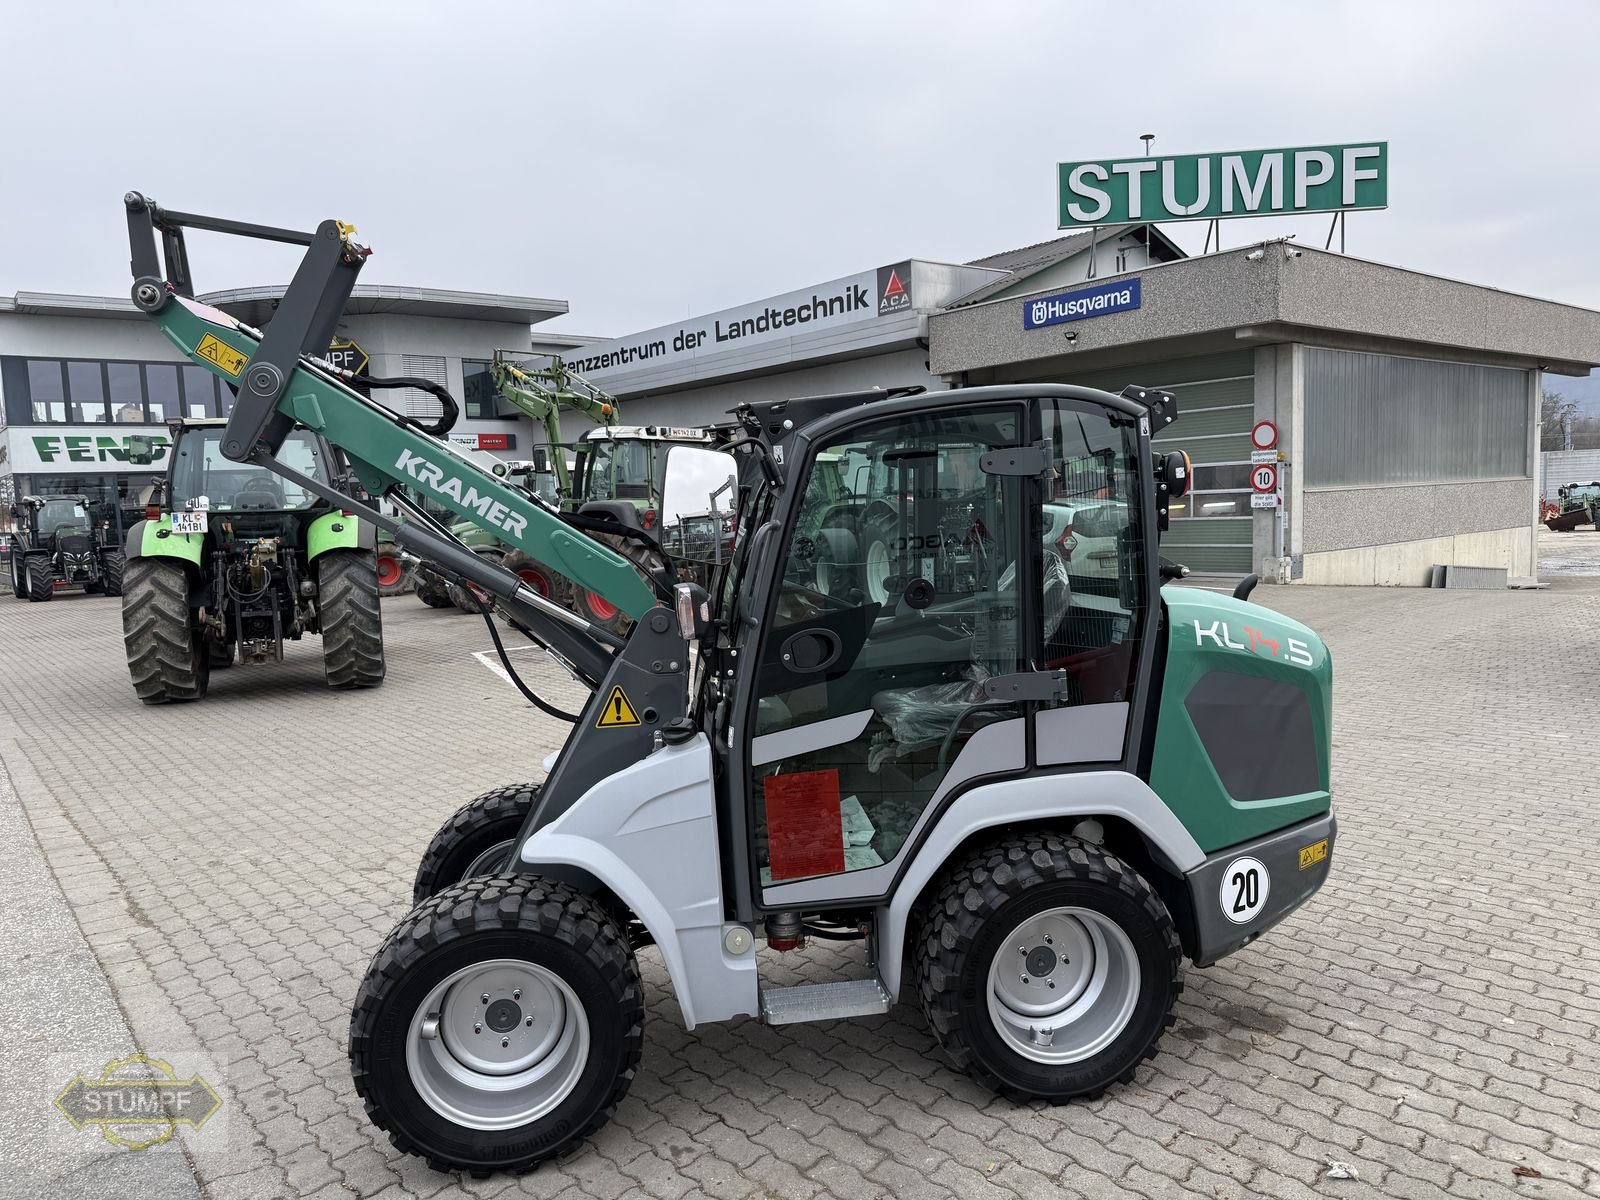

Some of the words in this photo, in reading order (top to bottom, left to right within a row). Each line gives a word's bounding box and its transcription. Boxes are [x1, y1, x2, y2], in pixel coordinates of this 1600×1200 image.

[1067, 146, 1380, 222] STUMPF
[672, 329, 707, 352] der
[715, 284, 870, 343] Landtechnik
[880, 293, 909, 308] ACA
[1048, 289, 1131, 318] Husqvarna
[32, 436, 168, 462] FEND
[394, 448, 528, 540] KRAMER
[1258, 471, 1270, 485] 10
[182, 514, 193, 523] KL
[1194, 619, 1313, 666] KL14.5
[1232, 868, 1259, 914] 20
